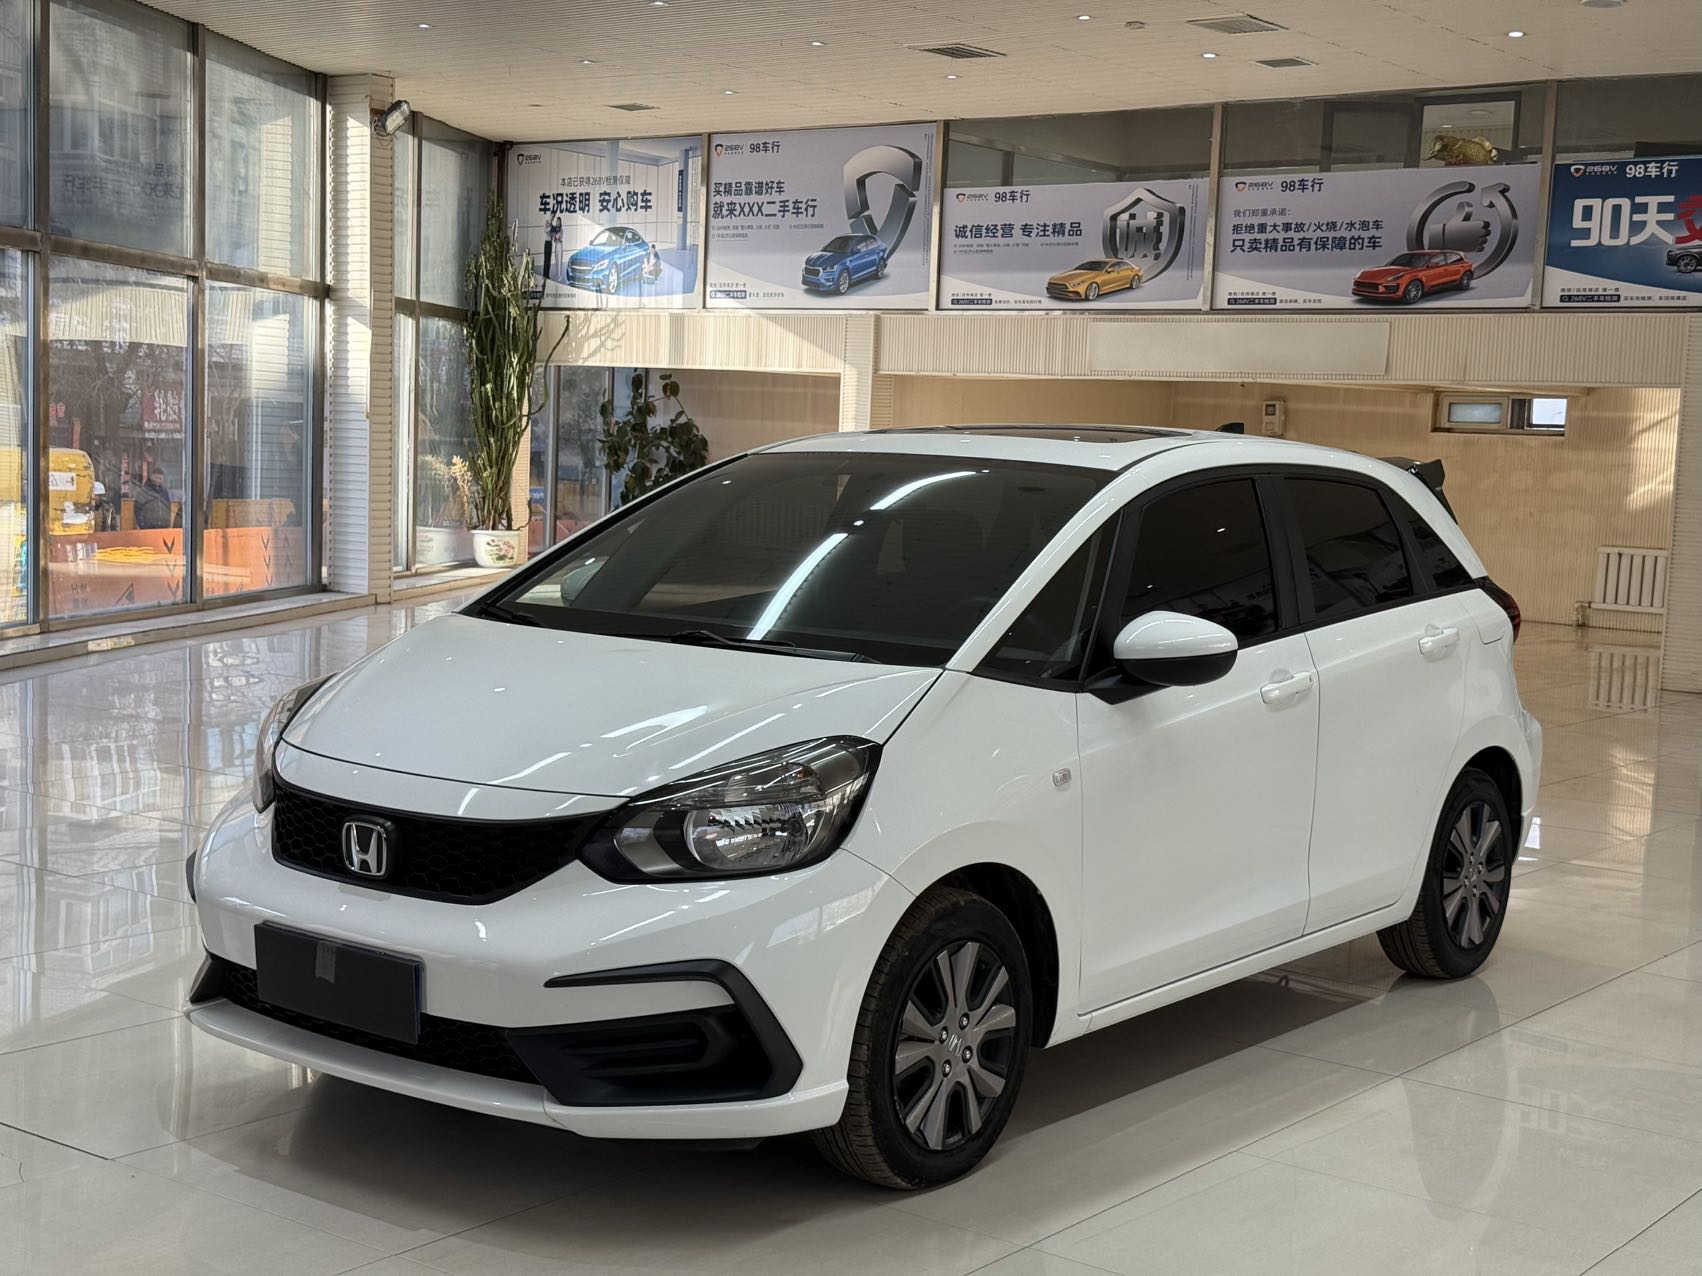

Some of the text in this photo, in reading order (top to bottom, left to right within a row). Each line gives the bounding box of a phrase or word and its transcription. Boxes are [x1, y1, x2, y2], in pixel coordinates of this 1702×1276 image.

[749, 141, 781, 154] 98车行
[1626, 162, 1679, 178] 98车行
[712, 179, 785, 197] 买精品靠谱好车
[1280, 177, 1324, 193] 98车行
[538, 192, 591, 215] 车况透明
[598, 189, 653, 213] 安心购车
[994, 189, 1031, 203] 98车行
[712, 198, 818, 220] 就来XXX二手车行
[953, 221, 1082, 239] 诚信经营 专注精品
[1231, 219, 1384, 235] 拒绝重大事故/火烧/水泡车
[1230, 235, 1383, 254] 只卖精品有保障的车
